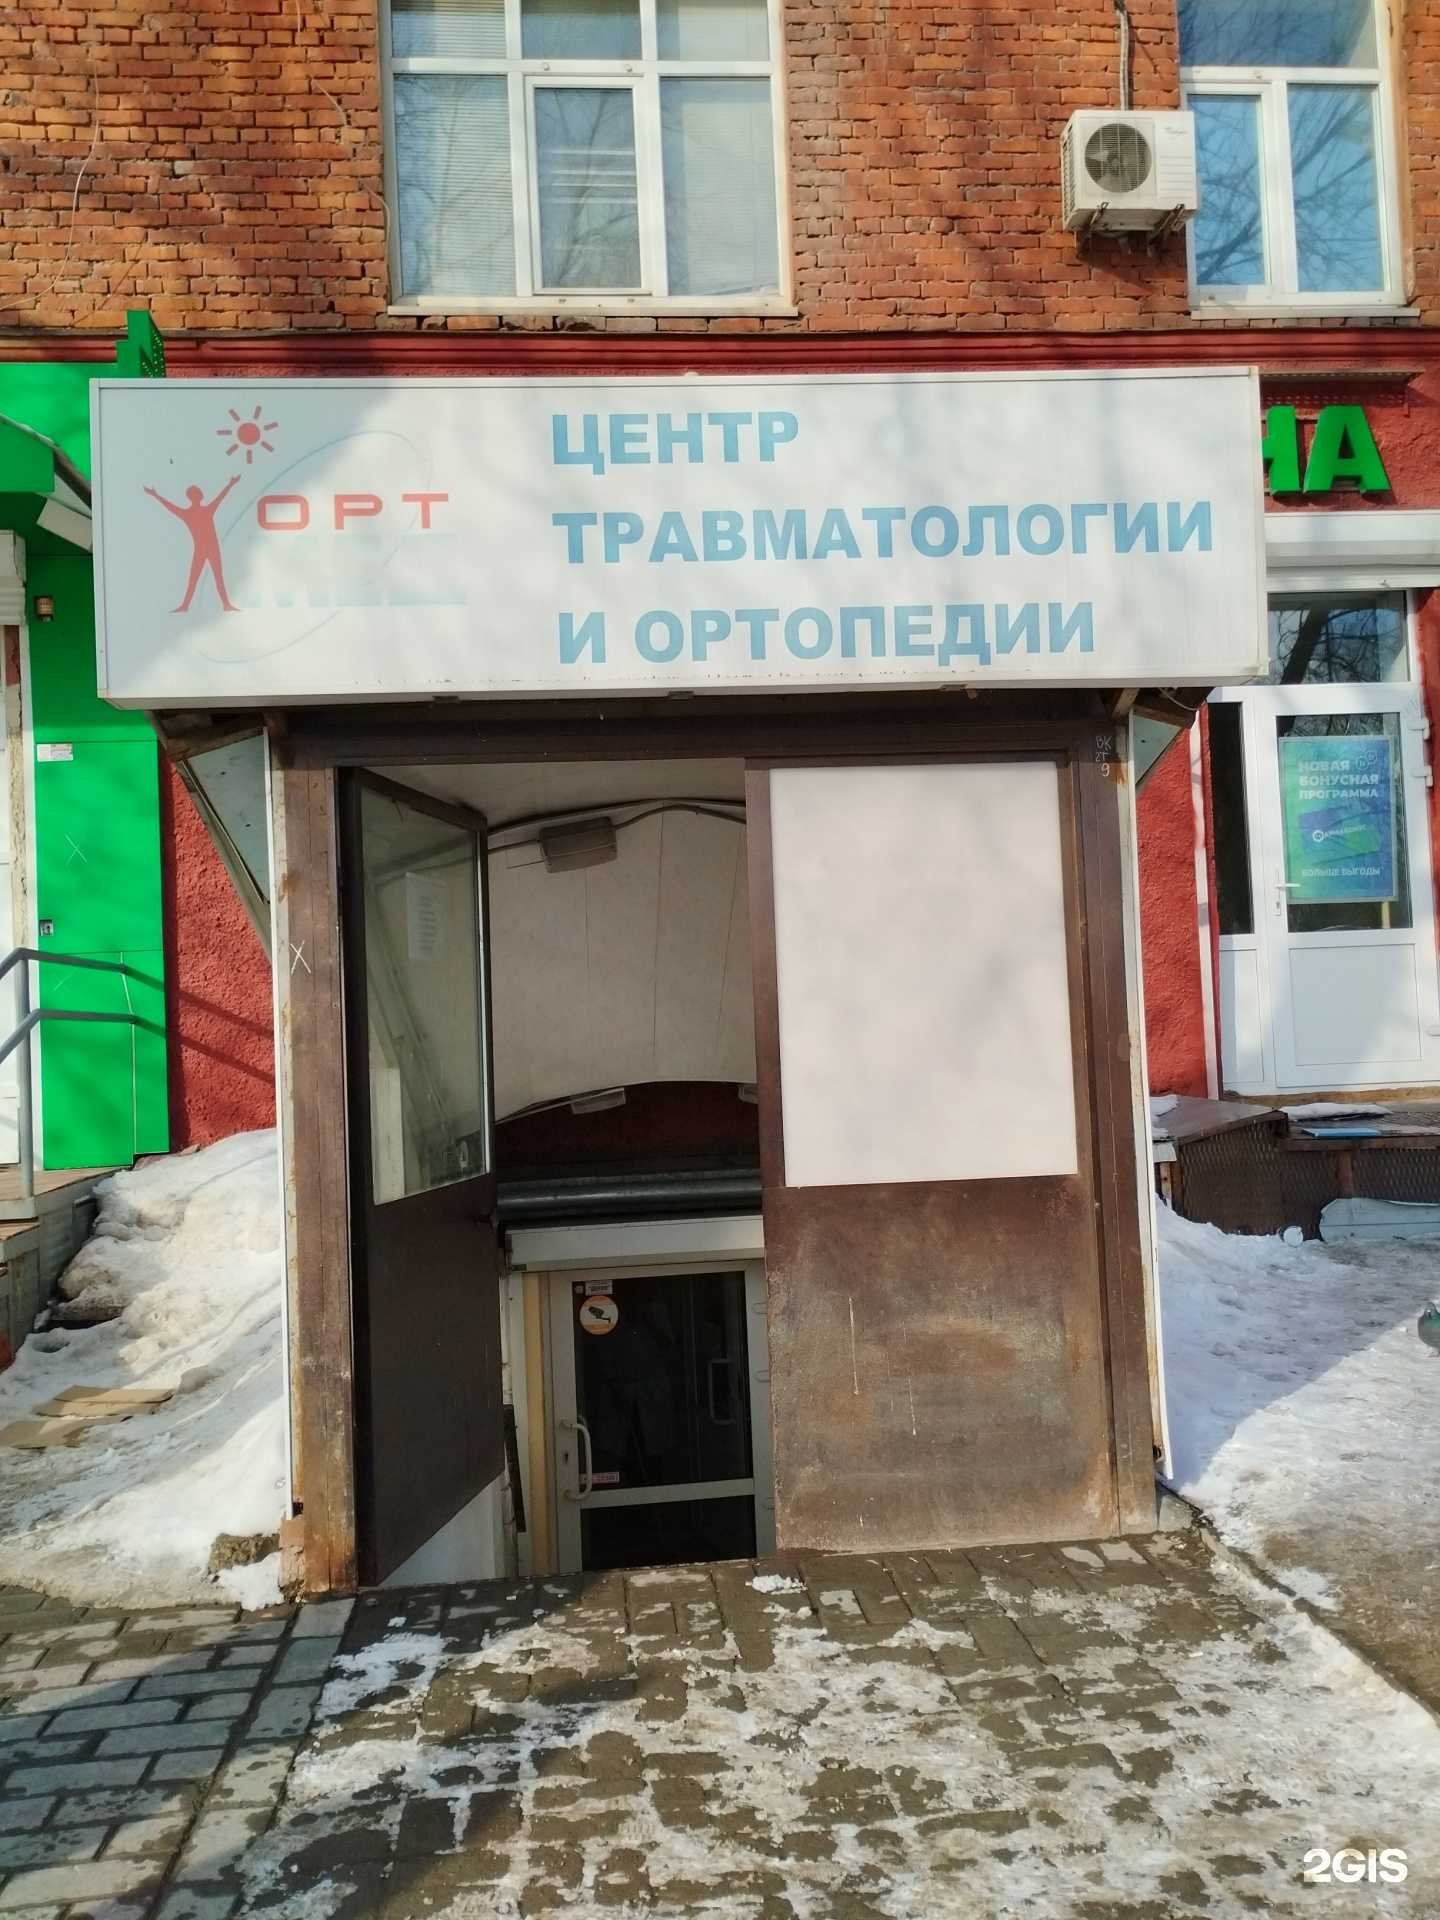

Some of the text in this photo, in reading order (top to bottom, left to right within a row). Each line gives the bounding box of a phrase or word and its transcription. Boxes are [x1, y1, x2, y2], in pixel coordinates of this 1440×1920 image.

[553, 411, 798, 475] ЦЕНТР
[258, 493, 448, 530] ОРТ
[552, 501, 1211, 563] ТРАВМАТОЛОГИИ
[559, 602, 1094, 666] И ОРТОПЕДИИ
[1298, 760, 1350, 773] НОВАЯ
[1299, 774, 1379, 787] БОНУСНАЯ
[1299, 788, 1379, 800] ПРОГРАММА
